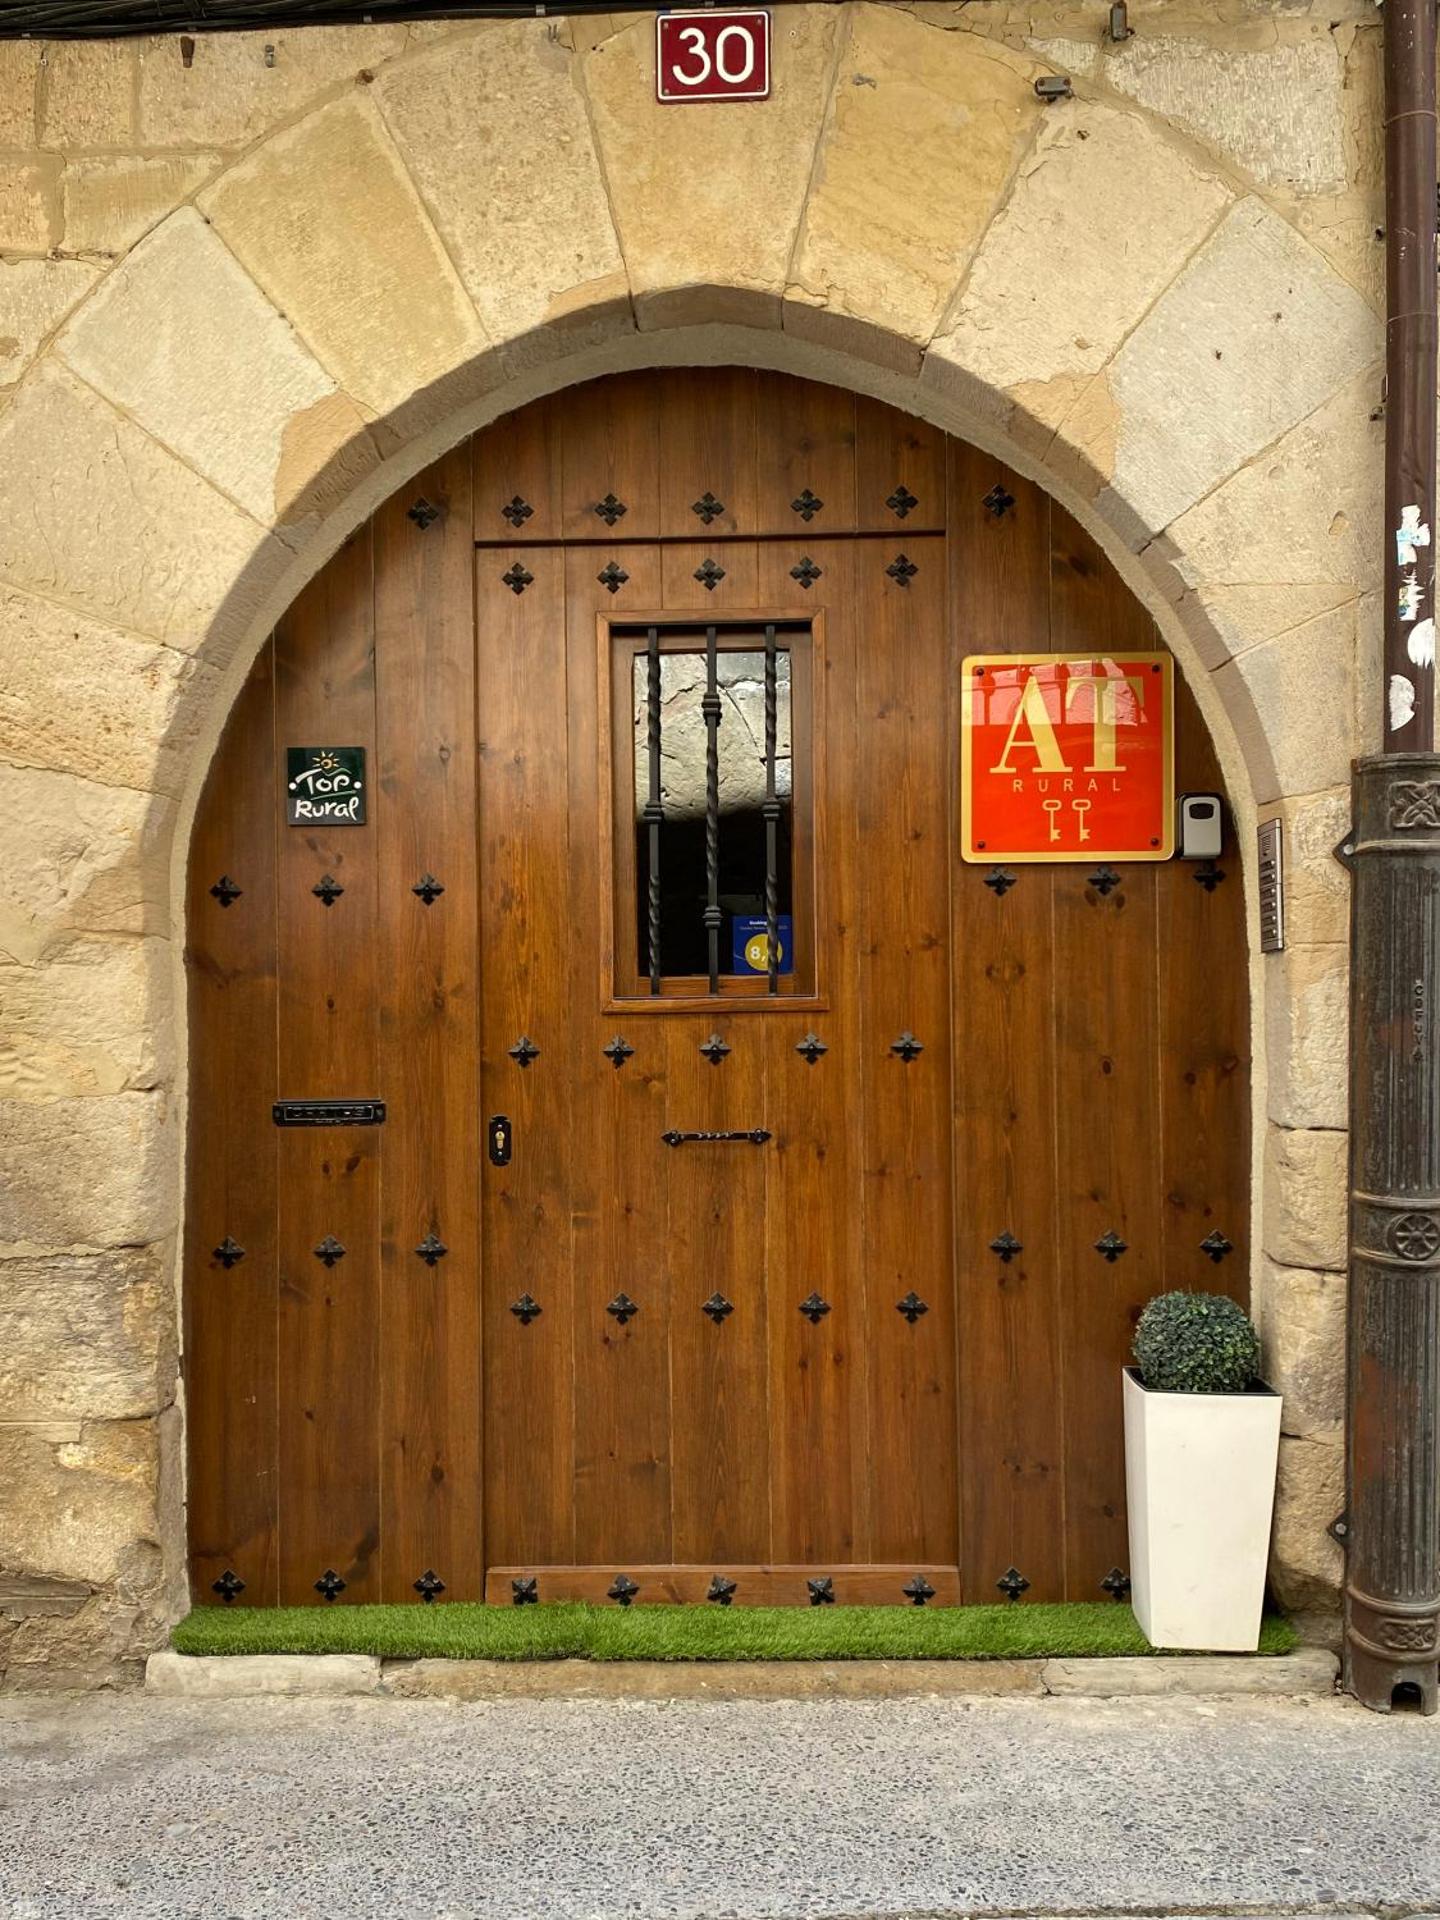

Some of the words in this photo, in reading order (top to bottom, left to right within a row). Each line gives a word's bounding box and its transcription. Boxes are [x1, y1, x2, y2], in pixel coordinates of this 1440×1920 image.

[672, 26, 754, 85] 30
[989, 675, 1145, 774] AT
[1013, 778, 1121, 793] RURAL
[295, 797, 359, 821] Rural
